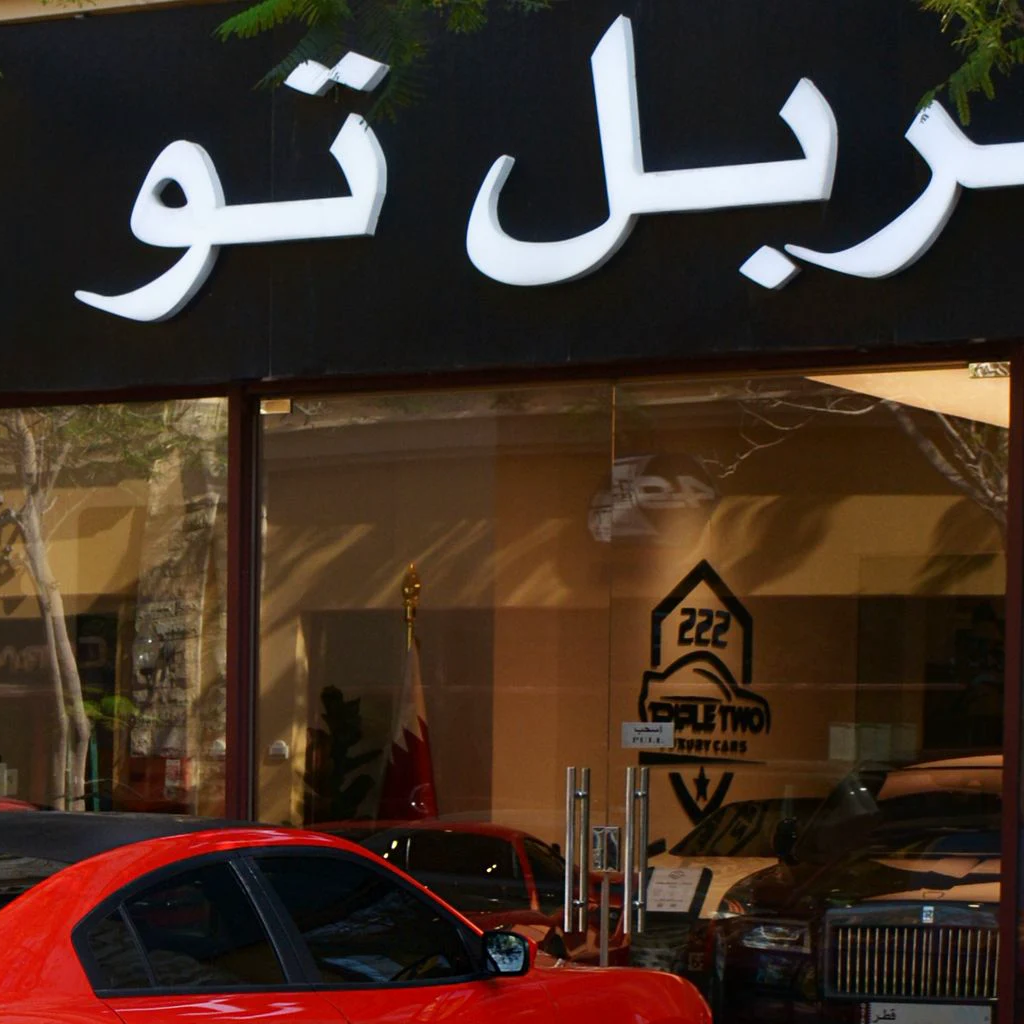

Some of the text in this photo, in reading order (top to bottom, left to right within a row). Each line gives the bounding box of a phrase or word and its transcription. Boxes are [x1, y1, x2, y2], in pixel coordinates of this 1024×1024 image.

[74, 14, 1024, 321] ربل تو
[678, 607, 731, 648] 222
[717, 704, 764, 734] TWO
